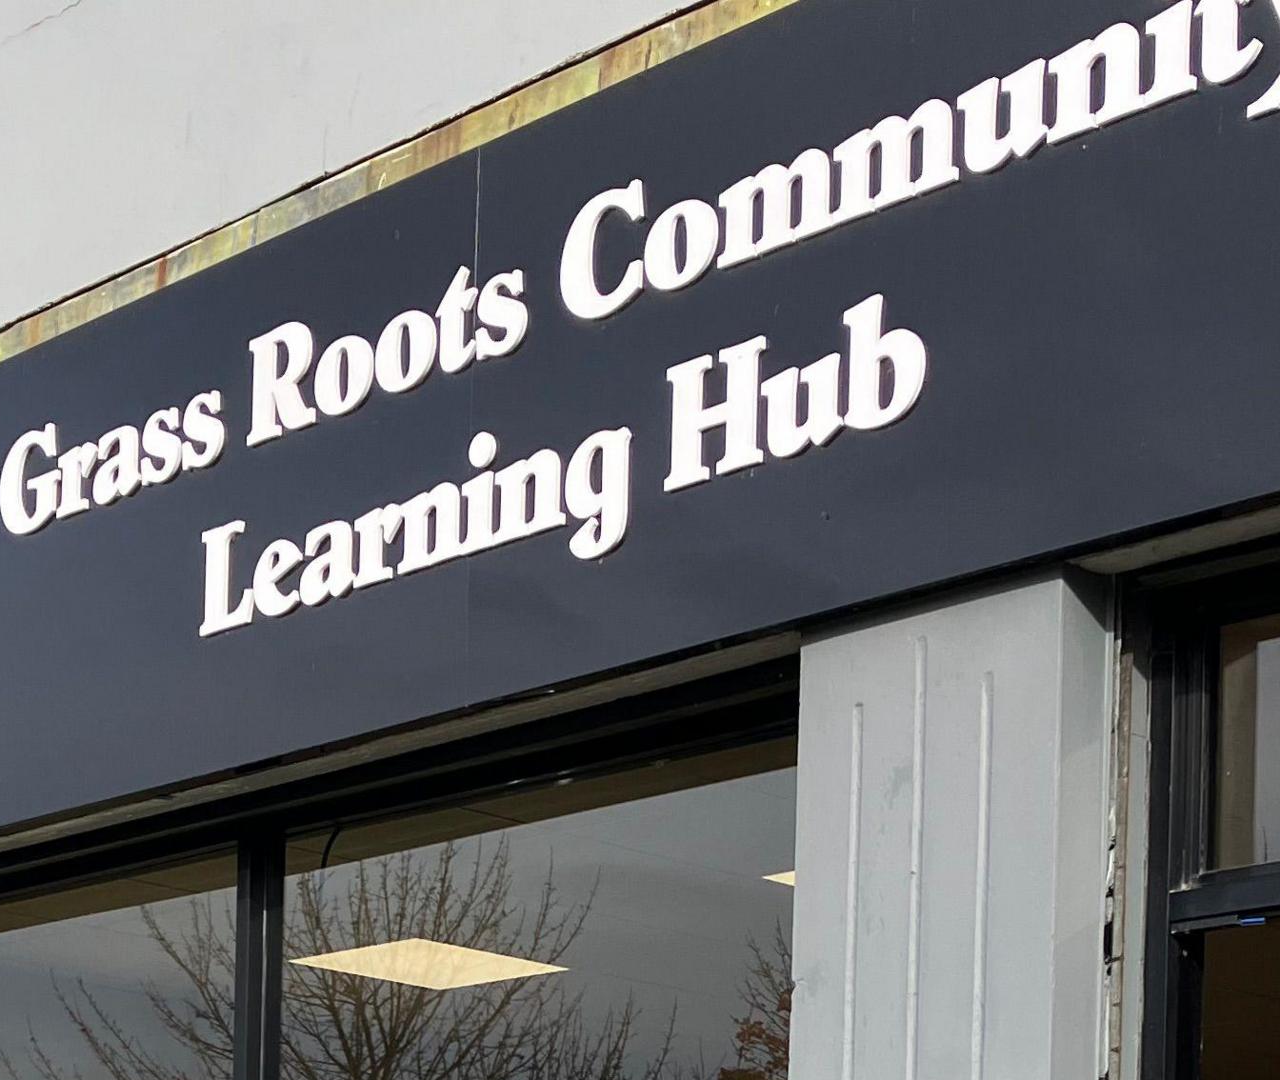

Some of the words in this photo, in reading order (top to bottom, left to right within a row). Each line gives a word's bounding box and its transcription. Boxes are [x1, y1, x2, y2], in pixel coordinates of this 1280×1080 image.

[0, 388, 226, 536] Grass
[246, 266, 529, 447] Roots
[199, 426, 632, 638] Learning
[664, 294, 927, 491] Hub
